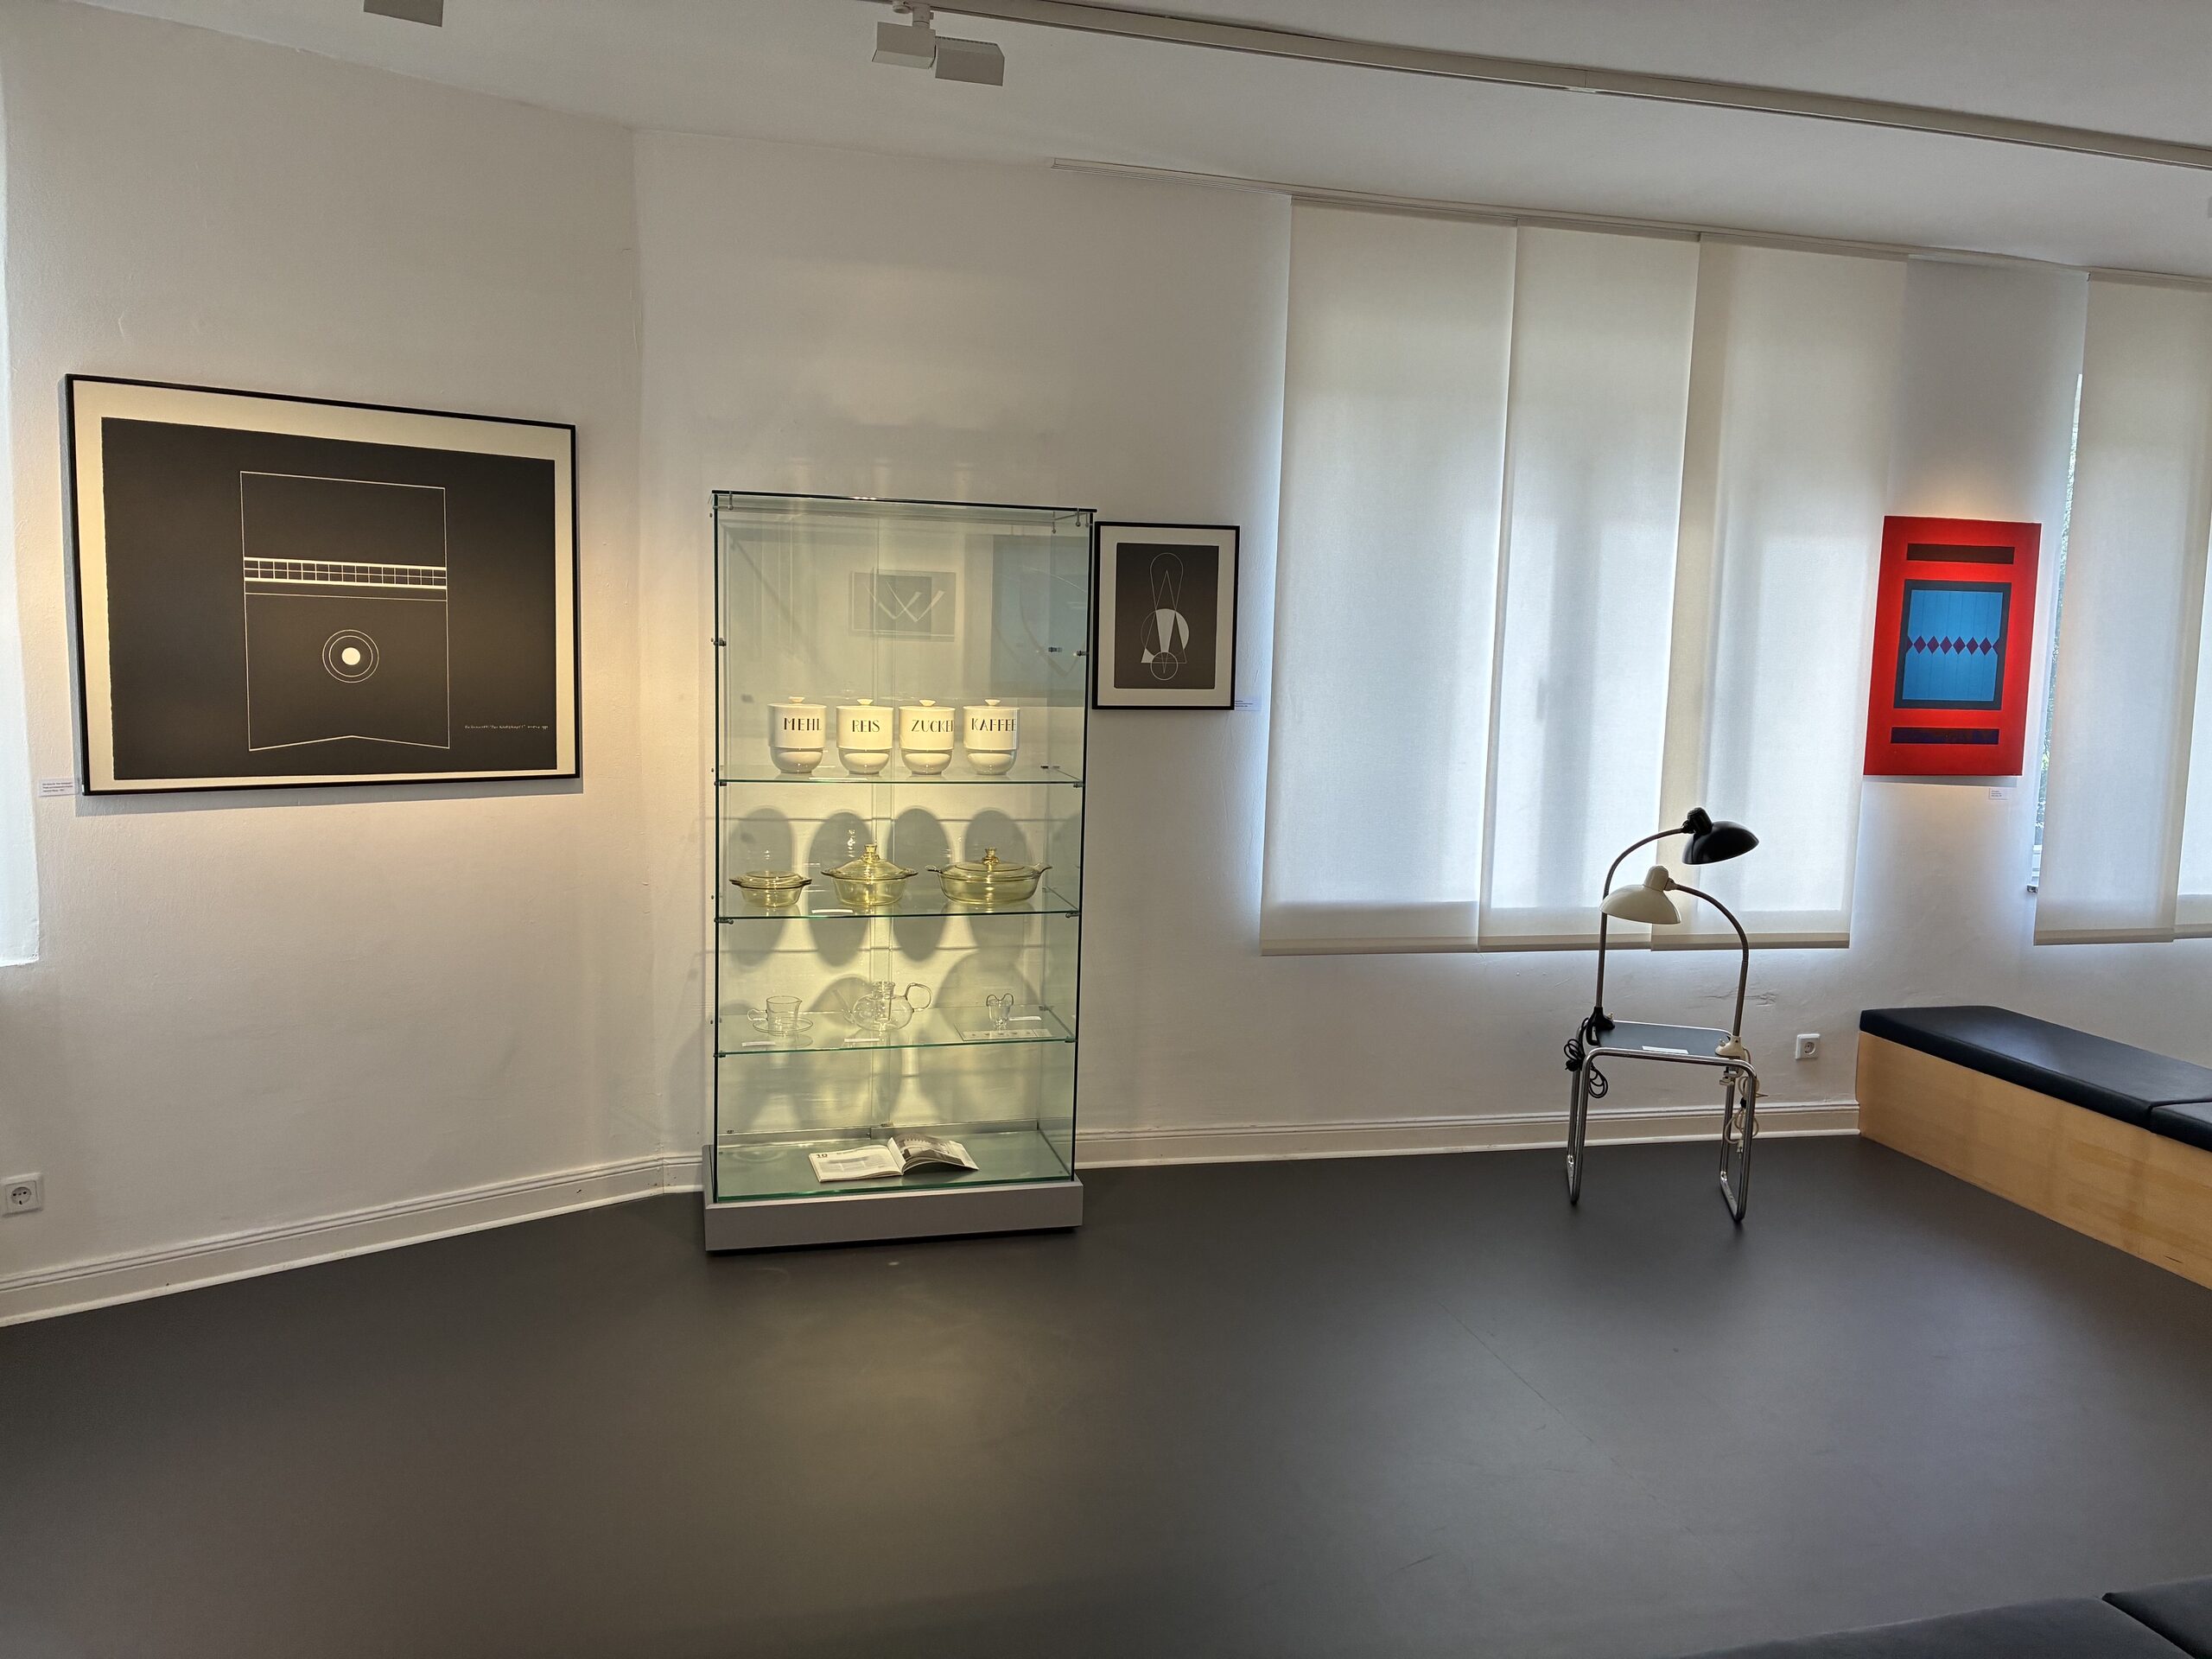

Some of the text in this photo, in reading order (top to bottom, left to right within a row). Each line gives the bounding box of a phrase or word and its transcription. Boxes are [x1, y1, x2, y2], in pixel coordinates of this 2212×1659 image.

[784, 718, 822, 731] MEHL
[852, 720, 880, 733] REIS
[971, 718, 1016, 732] KAFFEE
